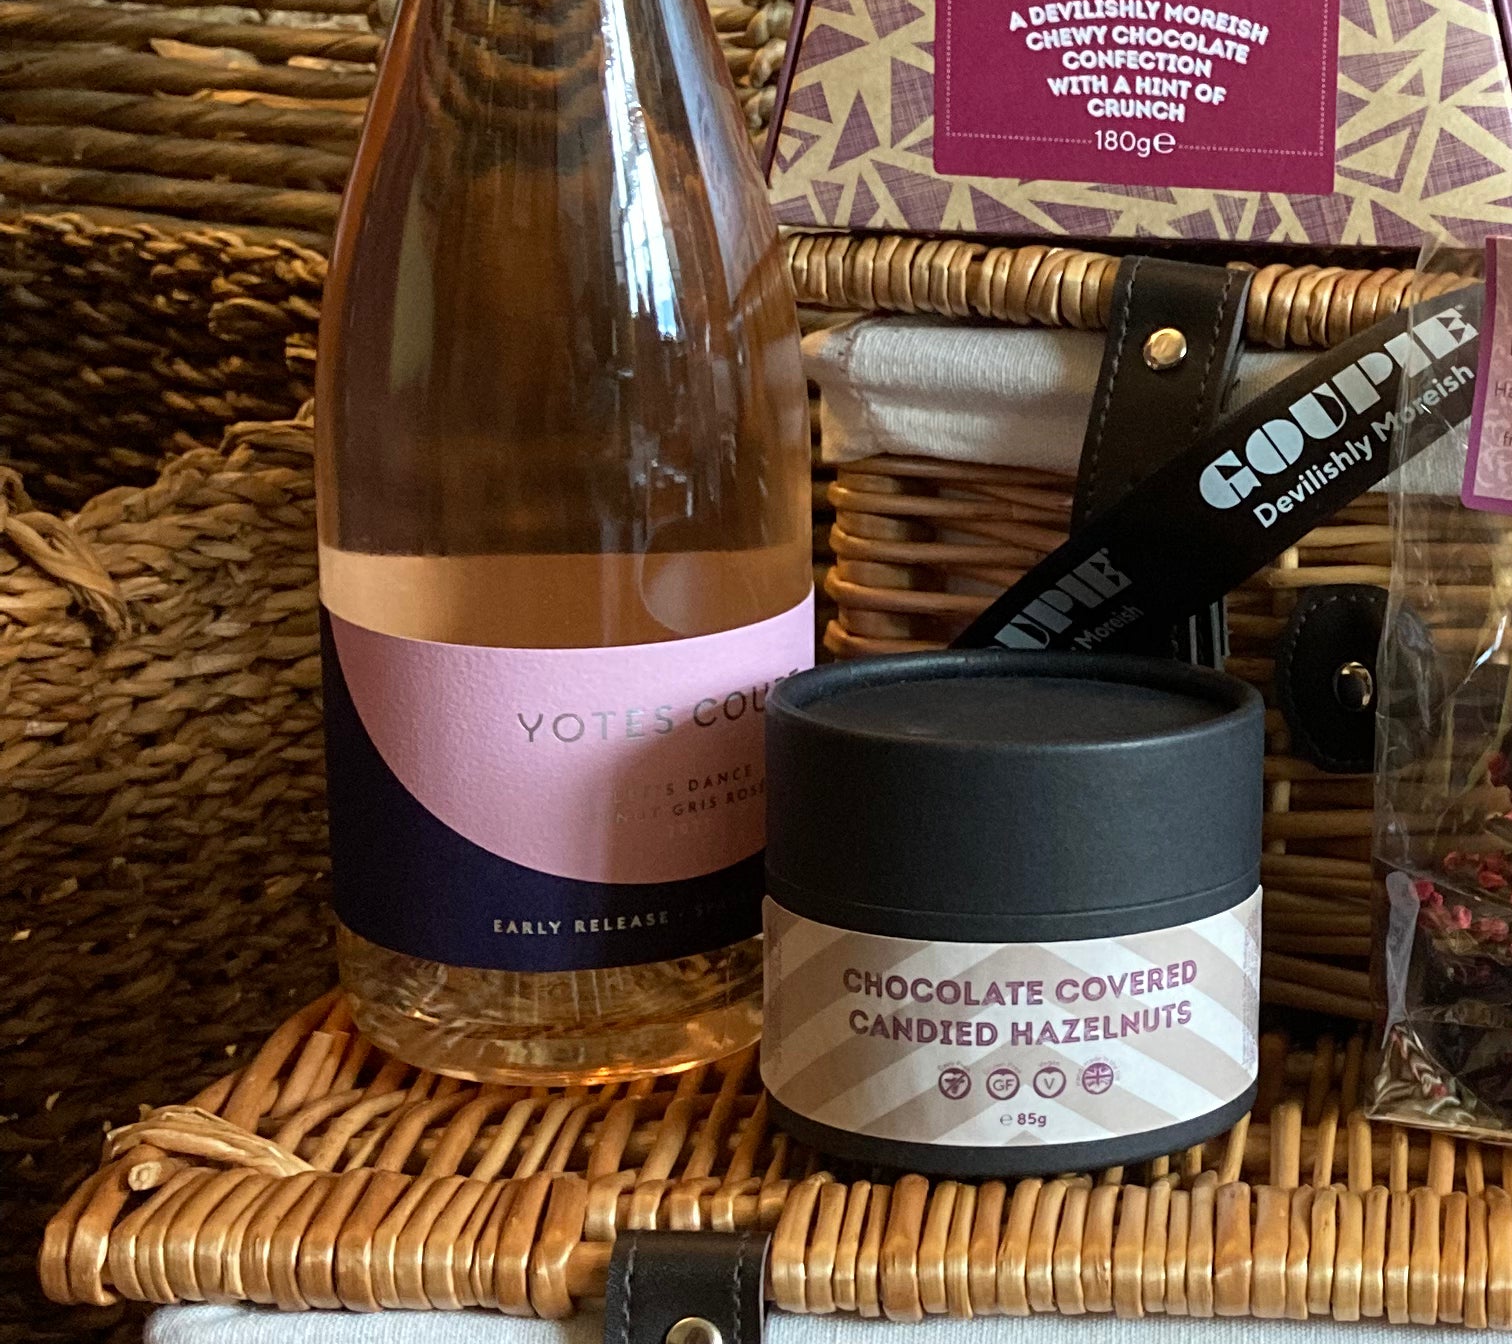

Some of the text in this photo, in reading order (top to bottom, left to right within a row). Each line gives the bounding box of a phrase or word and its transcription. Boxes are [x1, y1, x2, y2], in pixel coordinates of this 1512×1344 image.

[1009, 0, 1268, 44] A DEVILISHLY MOREISH
[1026, 26, 1250, 64] CHEWY CHOCOLATE
[1062, 51, 1212, 78] CONFECTION
[1047, 77, 1226, 106] WITH A HINT OF
[1088, 99, 1186, 122] CRUNCH
[1252, 362, 1475, 529] Devilishly Moreish
[1075, 604, 1144, 649] Moreish
[517, 668, 798, 743] YOTES COU
[688, 763, 753, 793] DANCE
[672, 795, 717, 817] GRIS
[493, 911, 668, 935] EARLY RELEASE
[843, 960, 1197, 1006] CHOCOLATE COVERED
[849, 1000, 1192, 1046] CANDIED HAZELNUTS
[992, 1079, 1014, 1091] GF
[1044, 1078, 1055, 1089] V
[1017, 1113, 1047, 1127] 85g
